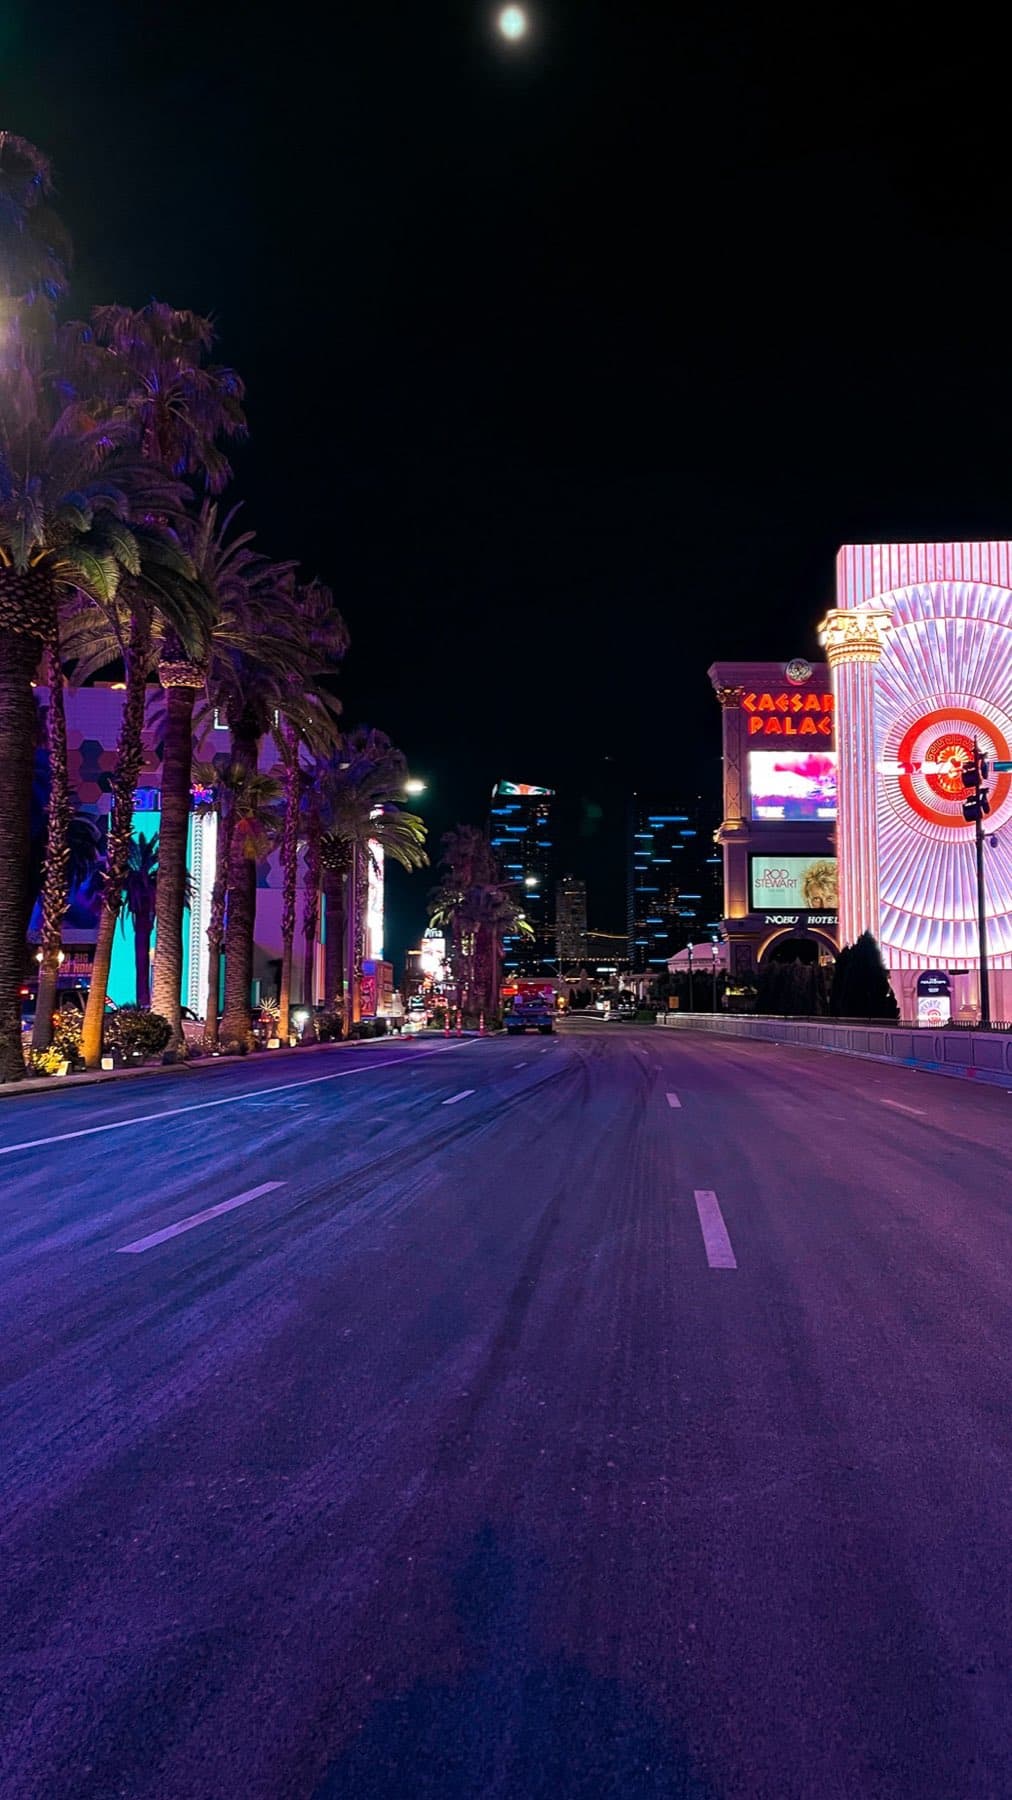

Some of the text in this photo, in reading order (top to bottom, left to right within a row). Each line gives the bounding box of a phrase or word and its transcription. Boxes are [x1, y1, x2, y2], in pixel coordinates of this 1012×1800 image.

[748, 716, 833, 736] PALAC
[763, 868, 790, 880] ROD
[754, 878, 798, 889] STEWART
[764, 915, 800, 925] NOBU
